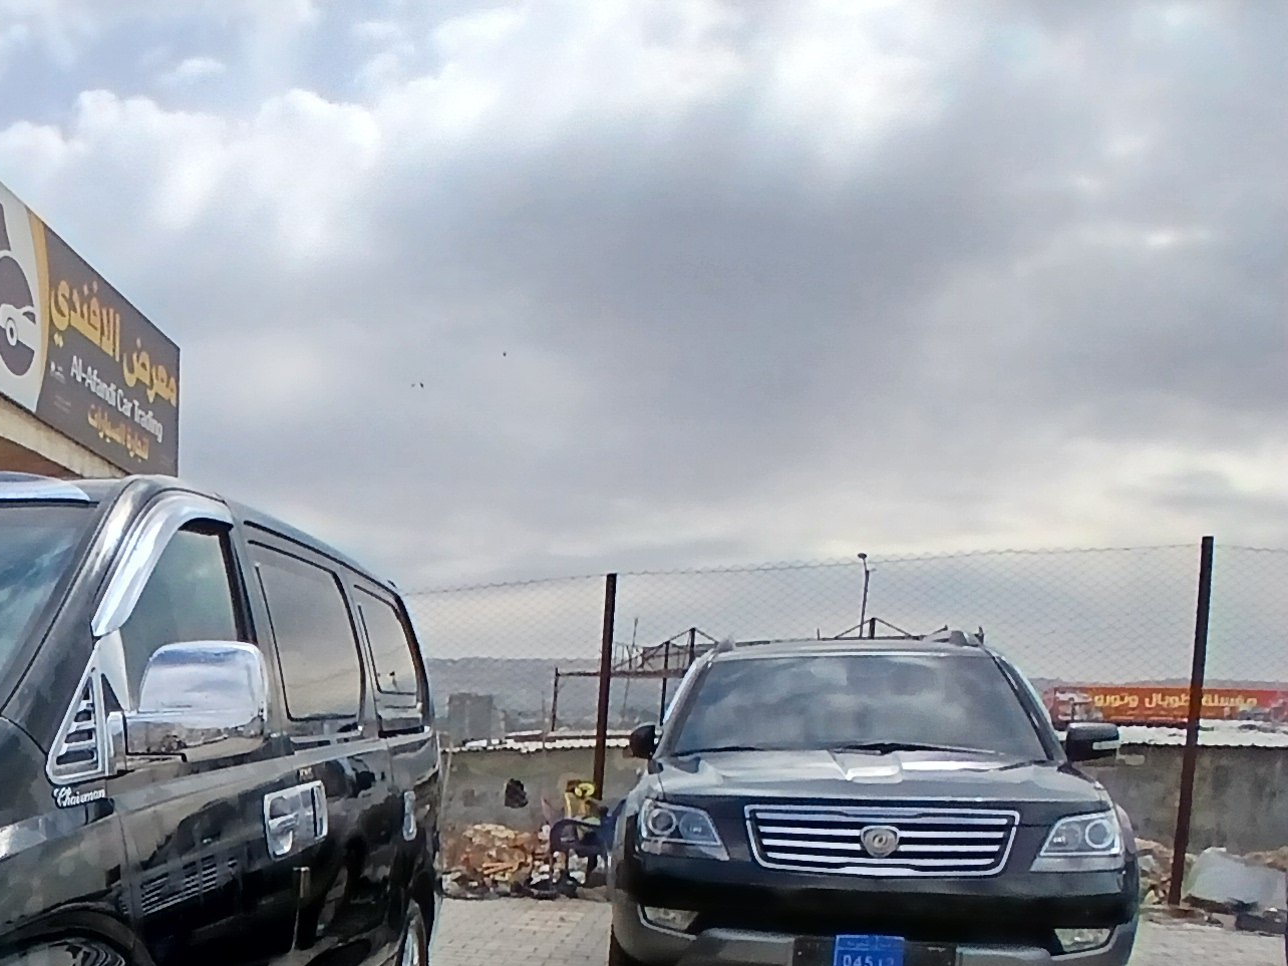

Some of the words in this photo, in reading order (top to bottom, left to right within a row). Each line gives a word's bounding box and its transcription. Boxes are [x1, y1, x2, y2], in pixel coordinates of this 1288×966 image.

[50, 280, 120, 362] الافندي
[123, 337, 177, 407] معرض
[117, 389, 133, 417] Car
[133, 399, 163, 443] Trading
